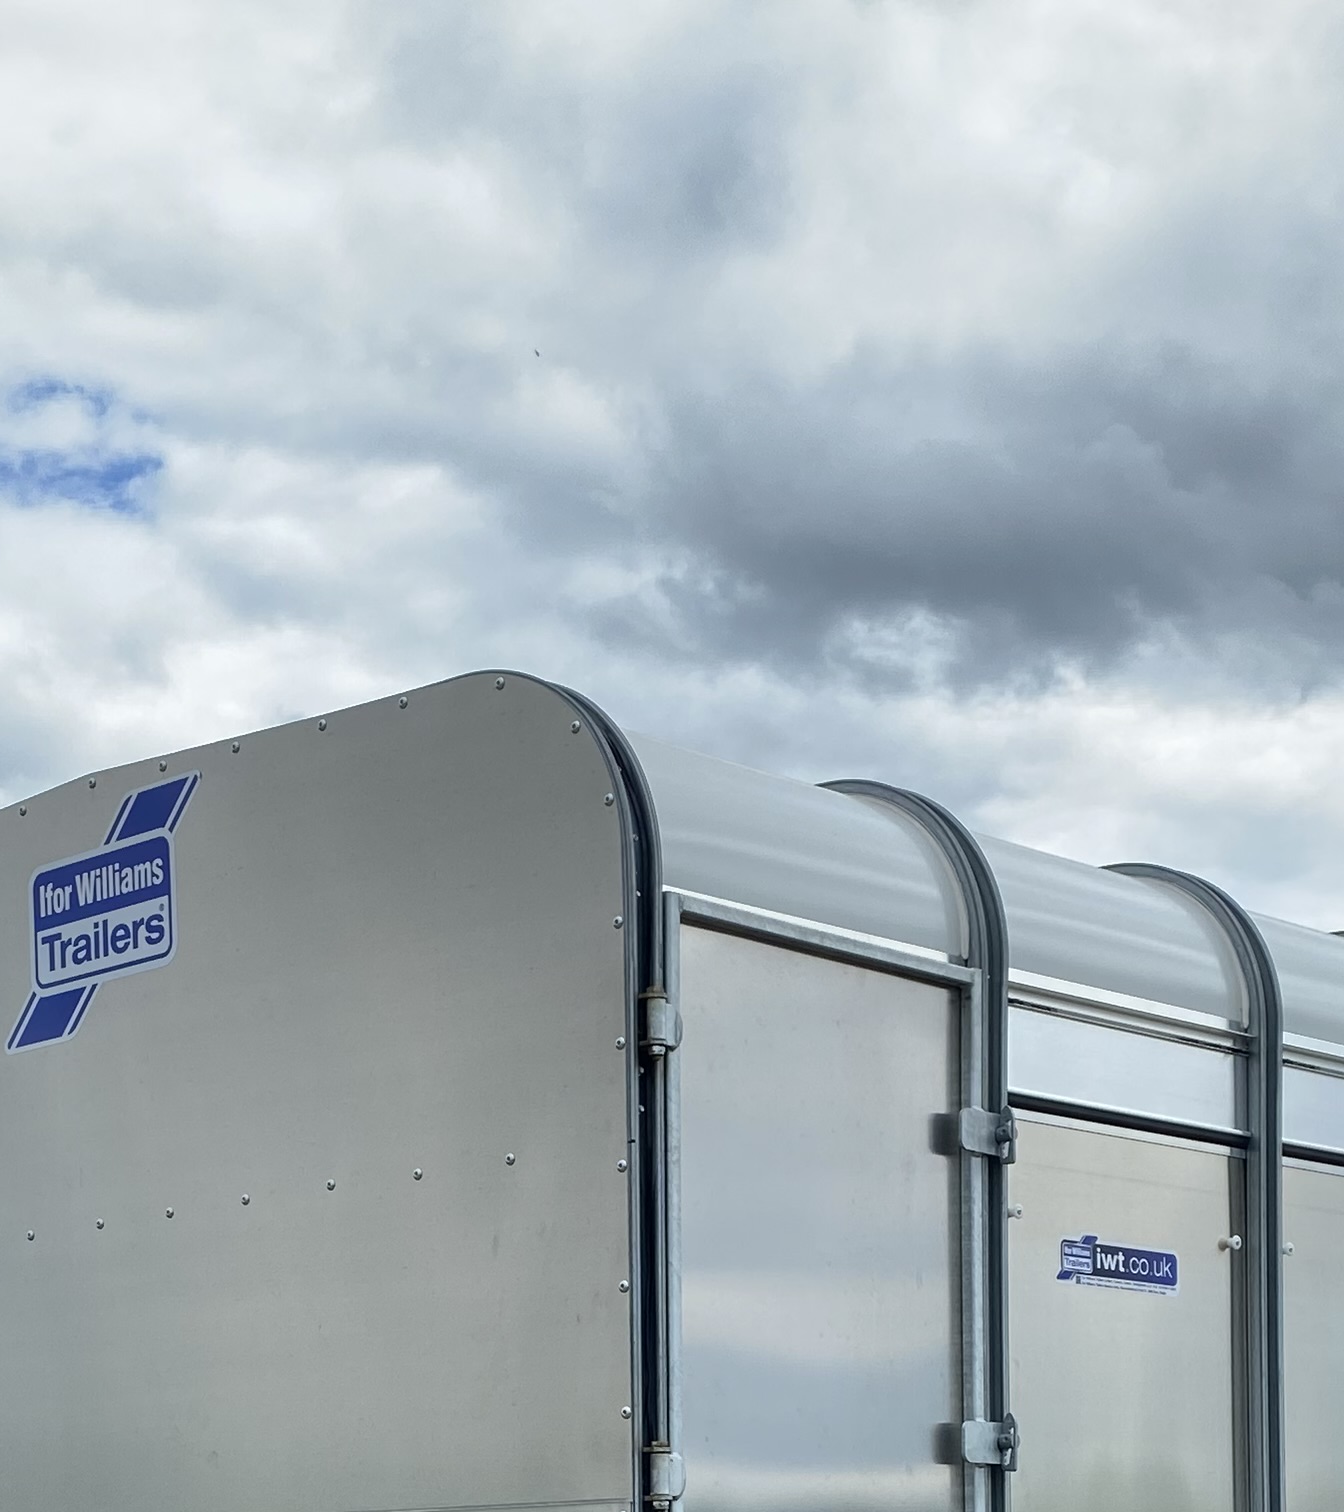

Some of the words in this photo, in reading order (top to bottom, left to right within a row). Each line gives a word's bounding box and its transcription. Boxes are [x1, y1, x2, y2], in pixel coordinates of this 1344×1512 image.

[39, 882, 73, 918] Ifor
[75, 857, 165, 907] Williams
[41, 913, 166, 972] Trailers
[1096, 1247, 1173, 1278] iwt.co.uk
